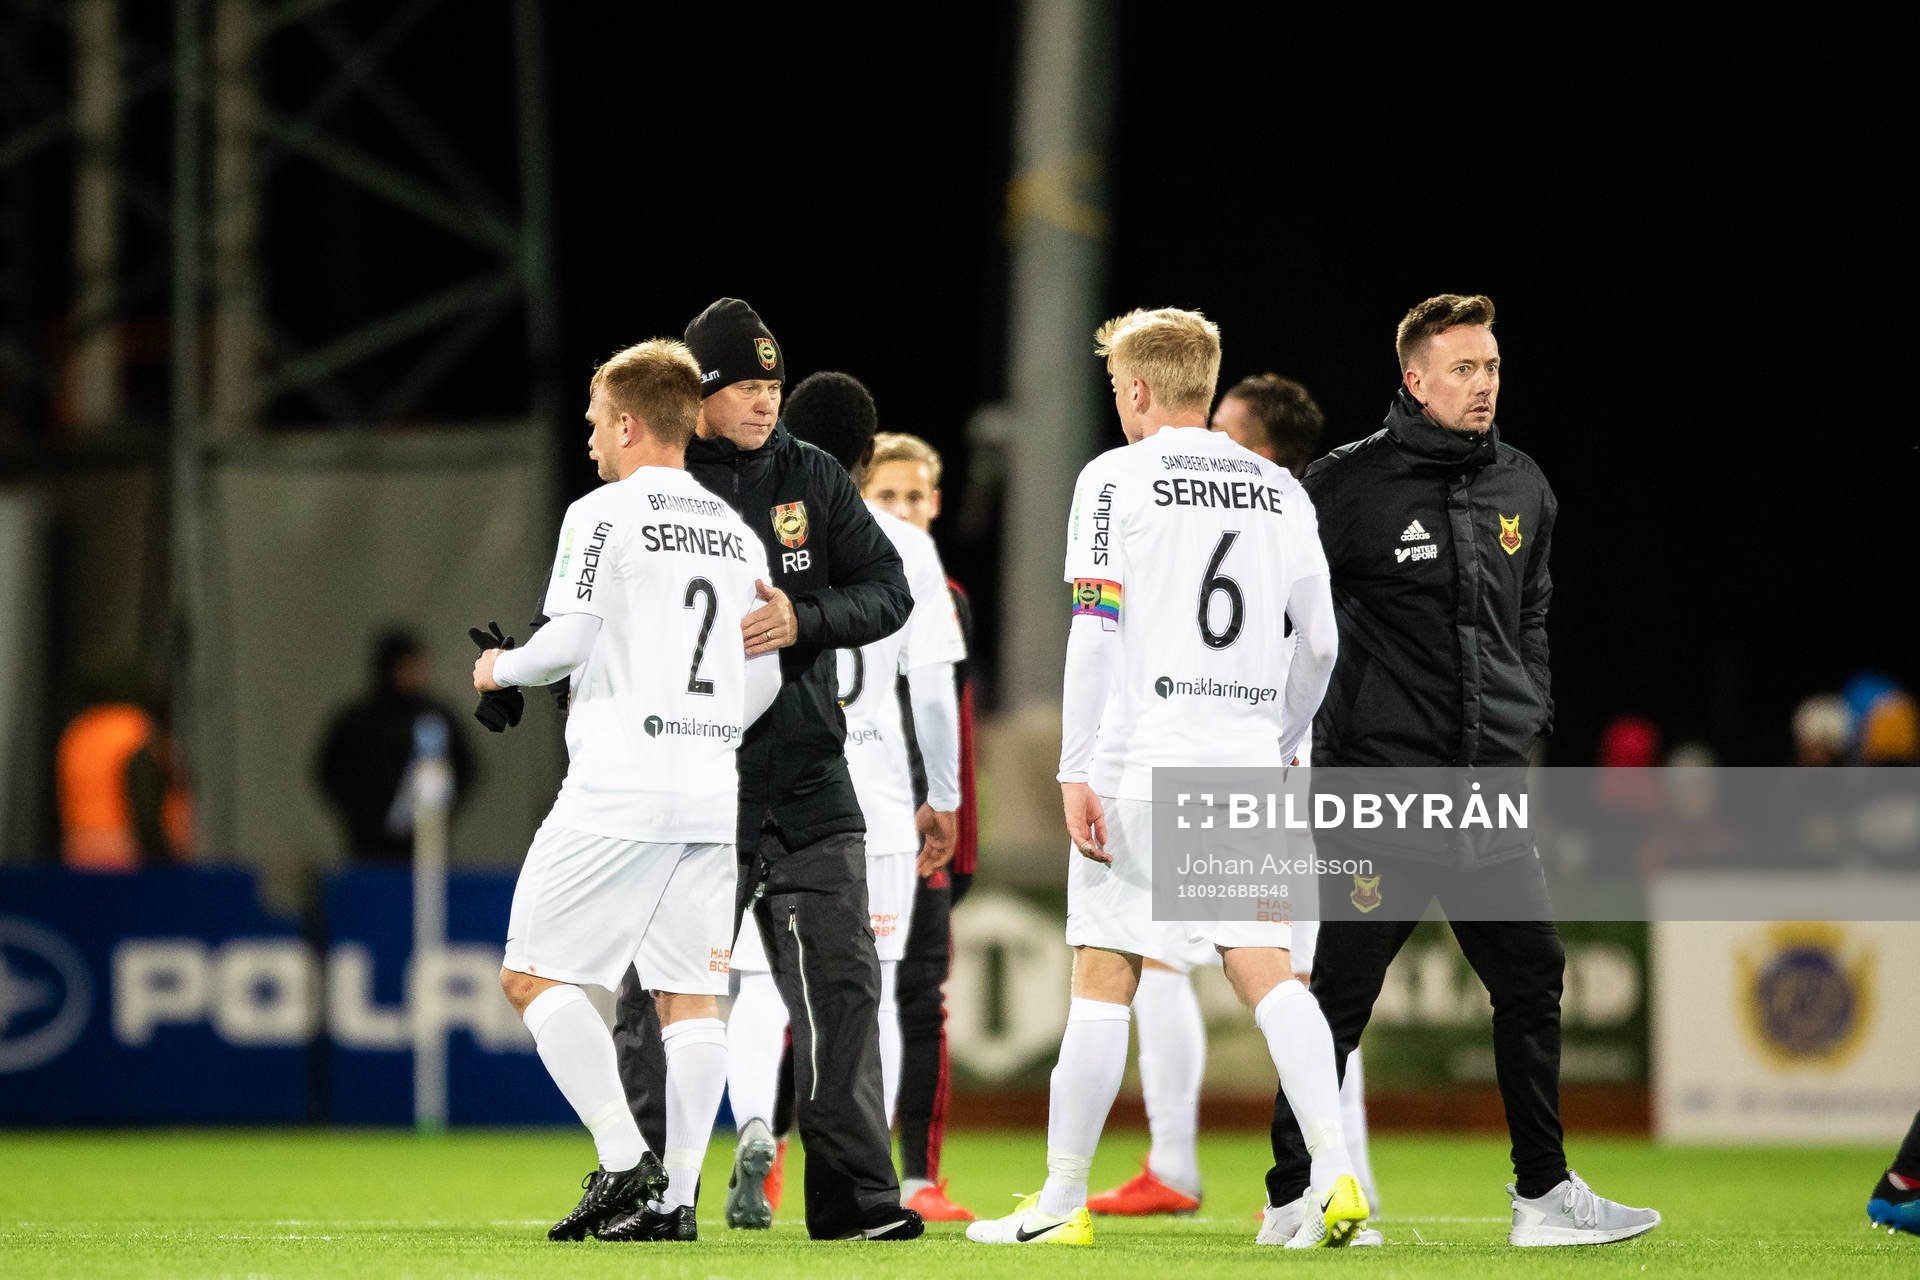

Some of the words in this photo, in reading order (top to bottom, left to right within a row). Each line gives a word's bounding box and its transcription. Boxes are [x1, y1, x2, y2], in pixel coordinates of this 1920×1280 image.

[1161, 455, 1209, 472] SANDBERG
[1208, 458, 1263, 478] MAGNUSSON
[648, 494, 728, 518] BRANDEBORN
[1153, 479, 1283, 514] SERNEKE
[1091, 482, 1117, 566] stadium
[1400, 532, 1431, 541] adidas
[641, 524, 747, 562] SERNEKE
[1411, 544, 1438, 554] INTER
[1411, 551, 1439, 561] SPORT
[576, 521, 614, 602] stadium
[782, 550, 811, 573] RB
[1196, 530, 1246, 651] 6
[683, 575, 719, 697] 2
[1176, 677, 1278, 705] mäklarringen
[1256, 898, 1293, 912] HAP
